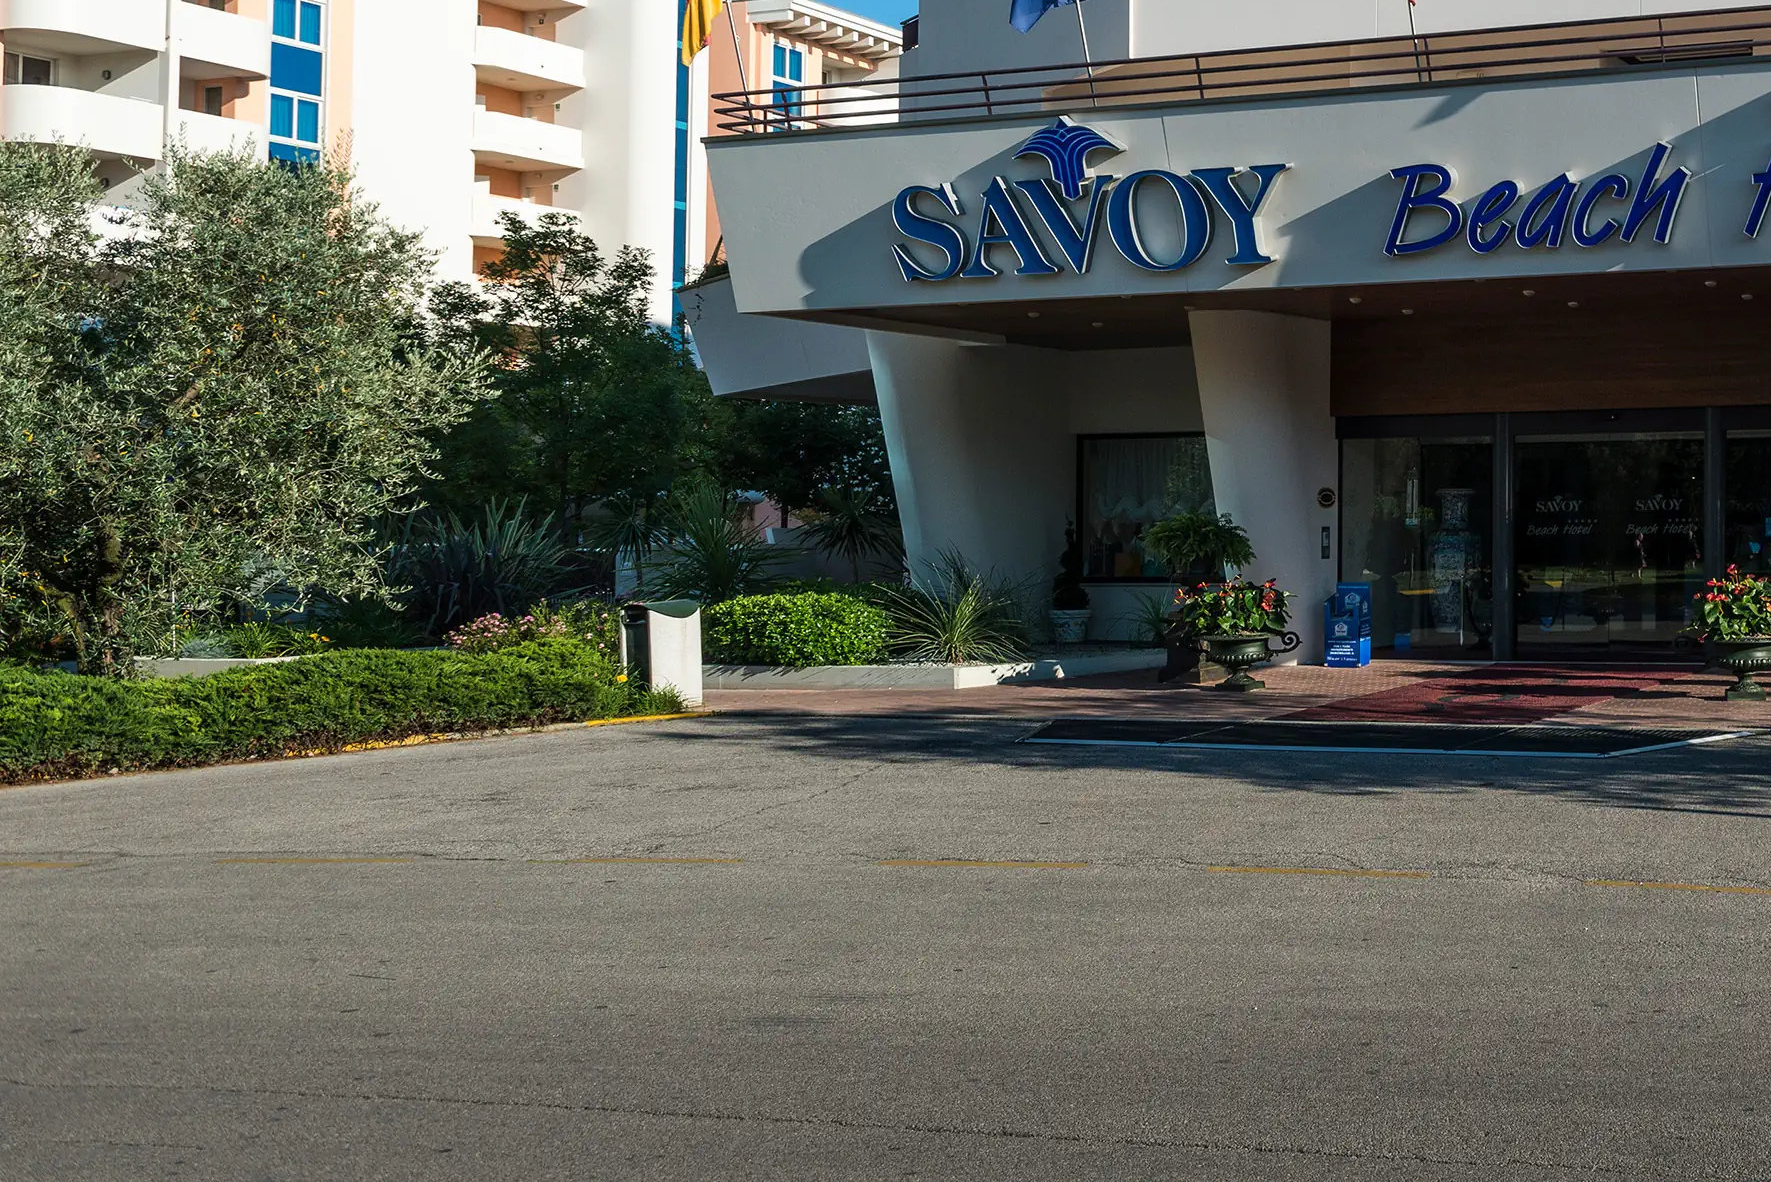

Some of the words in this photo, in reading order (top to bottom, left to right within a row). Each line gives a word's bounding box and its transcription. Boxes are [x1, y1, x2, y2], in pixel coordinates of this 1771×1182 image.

[891, 163, 1294, 283] SAVOY
[1382, 139, 1694, 258] Beach
[1535, 500, 1582, 513] SAVOY
[1635, 498, 1682, 511] SAVOY
[1526, 524, 1559, 536] Beach
[1562, 523, 1594, 535] Hotel
[1625, 523, 1658, 535] Beach
